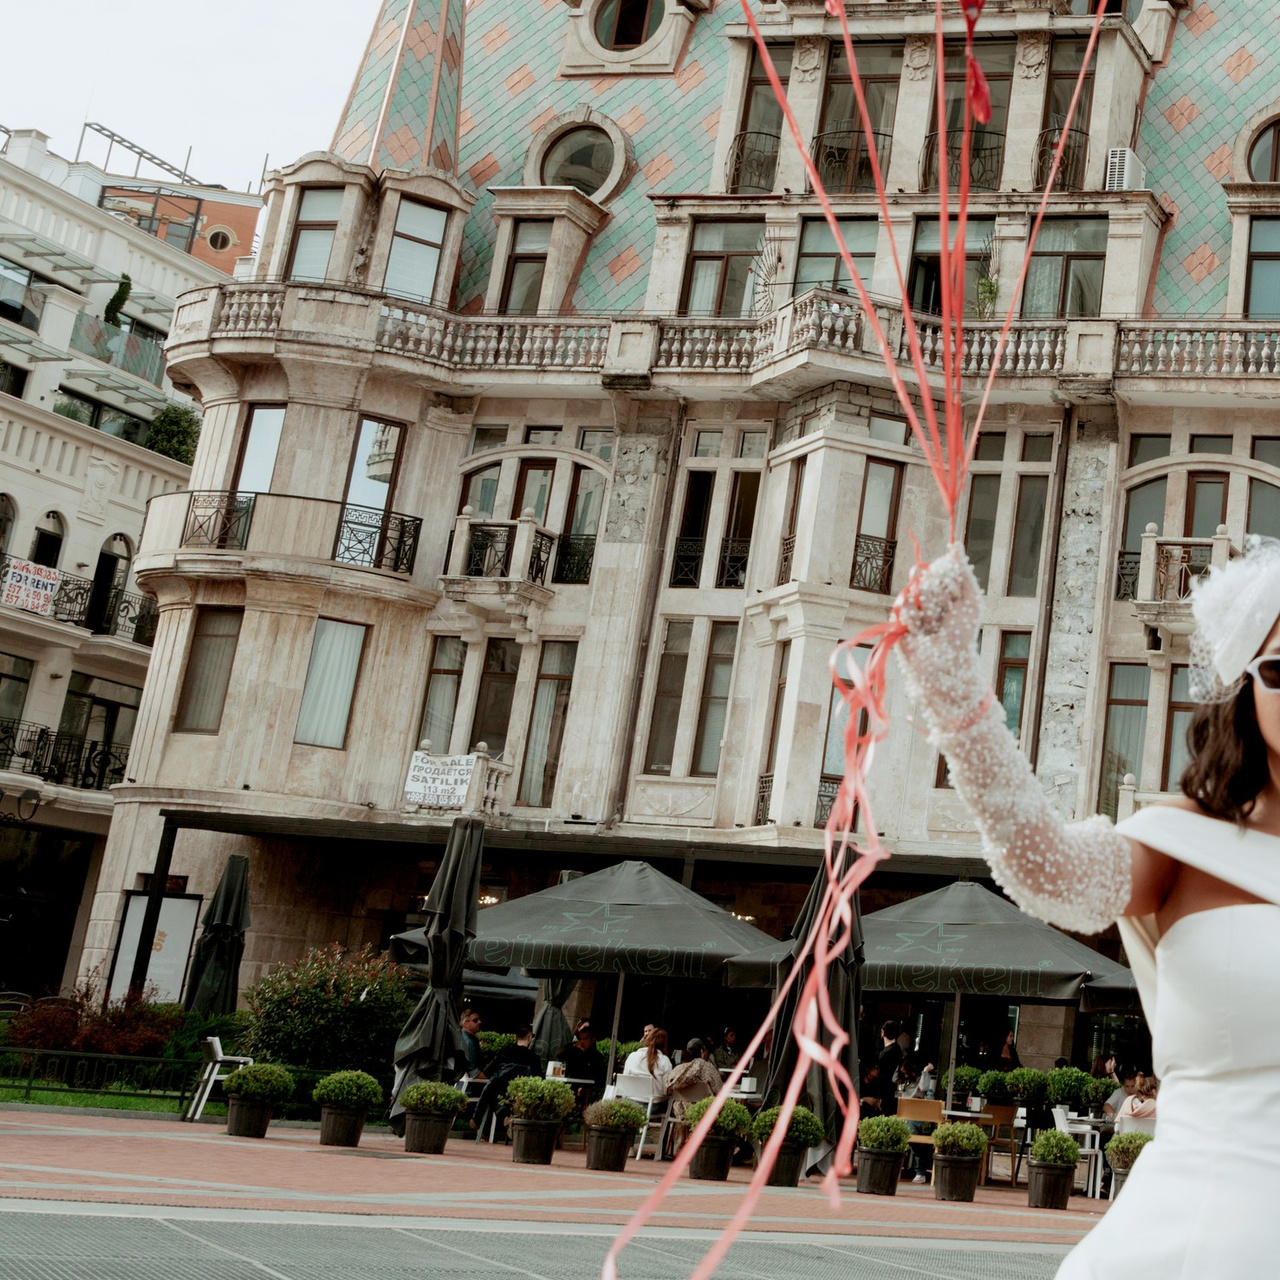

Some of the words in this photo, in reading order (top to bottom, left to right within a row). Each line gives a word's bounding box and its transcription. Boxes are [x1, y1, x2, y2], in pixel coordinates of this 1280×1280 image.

[11, 571, 29, 585] FOR
[30, 578, 56, 592] RENT
[414, 755, 437, 766] FOR
[410, 774, 470, 786] SATILIK
[423, 785, 438, 794] 113
[467, 933, 706, 978] eineken
